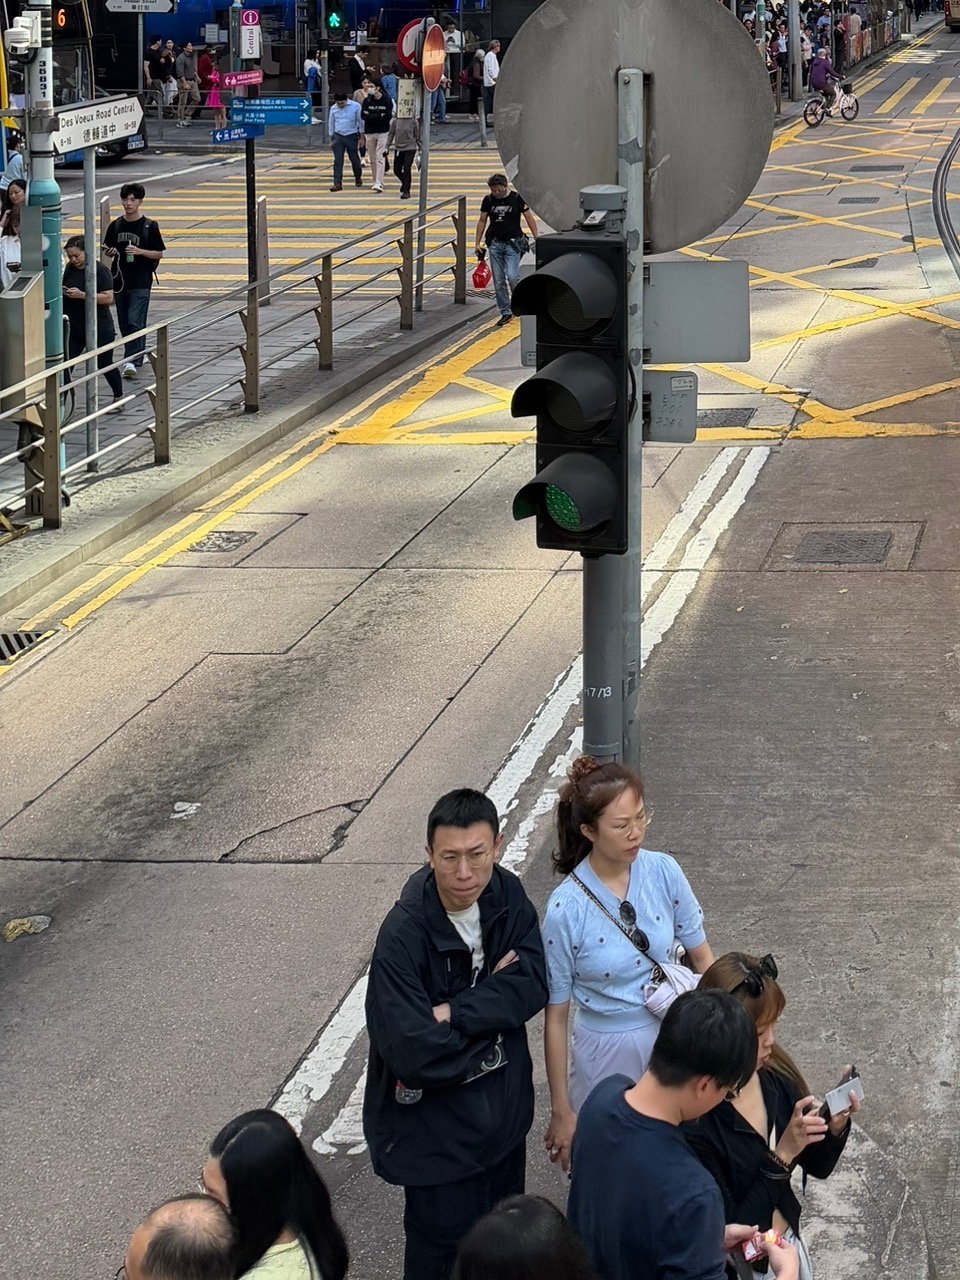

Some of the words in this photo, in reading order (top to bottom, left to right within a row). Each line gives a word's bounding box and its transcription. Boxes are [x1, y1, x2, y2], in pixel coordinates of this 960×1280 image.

[57, 8, 66, 27] 6
[60, 118, 73, 129] Des
[74, 112, 94, 126] Voeux
[96, 107, 112, 120] Road
[113, 102, 135, 116] Central
